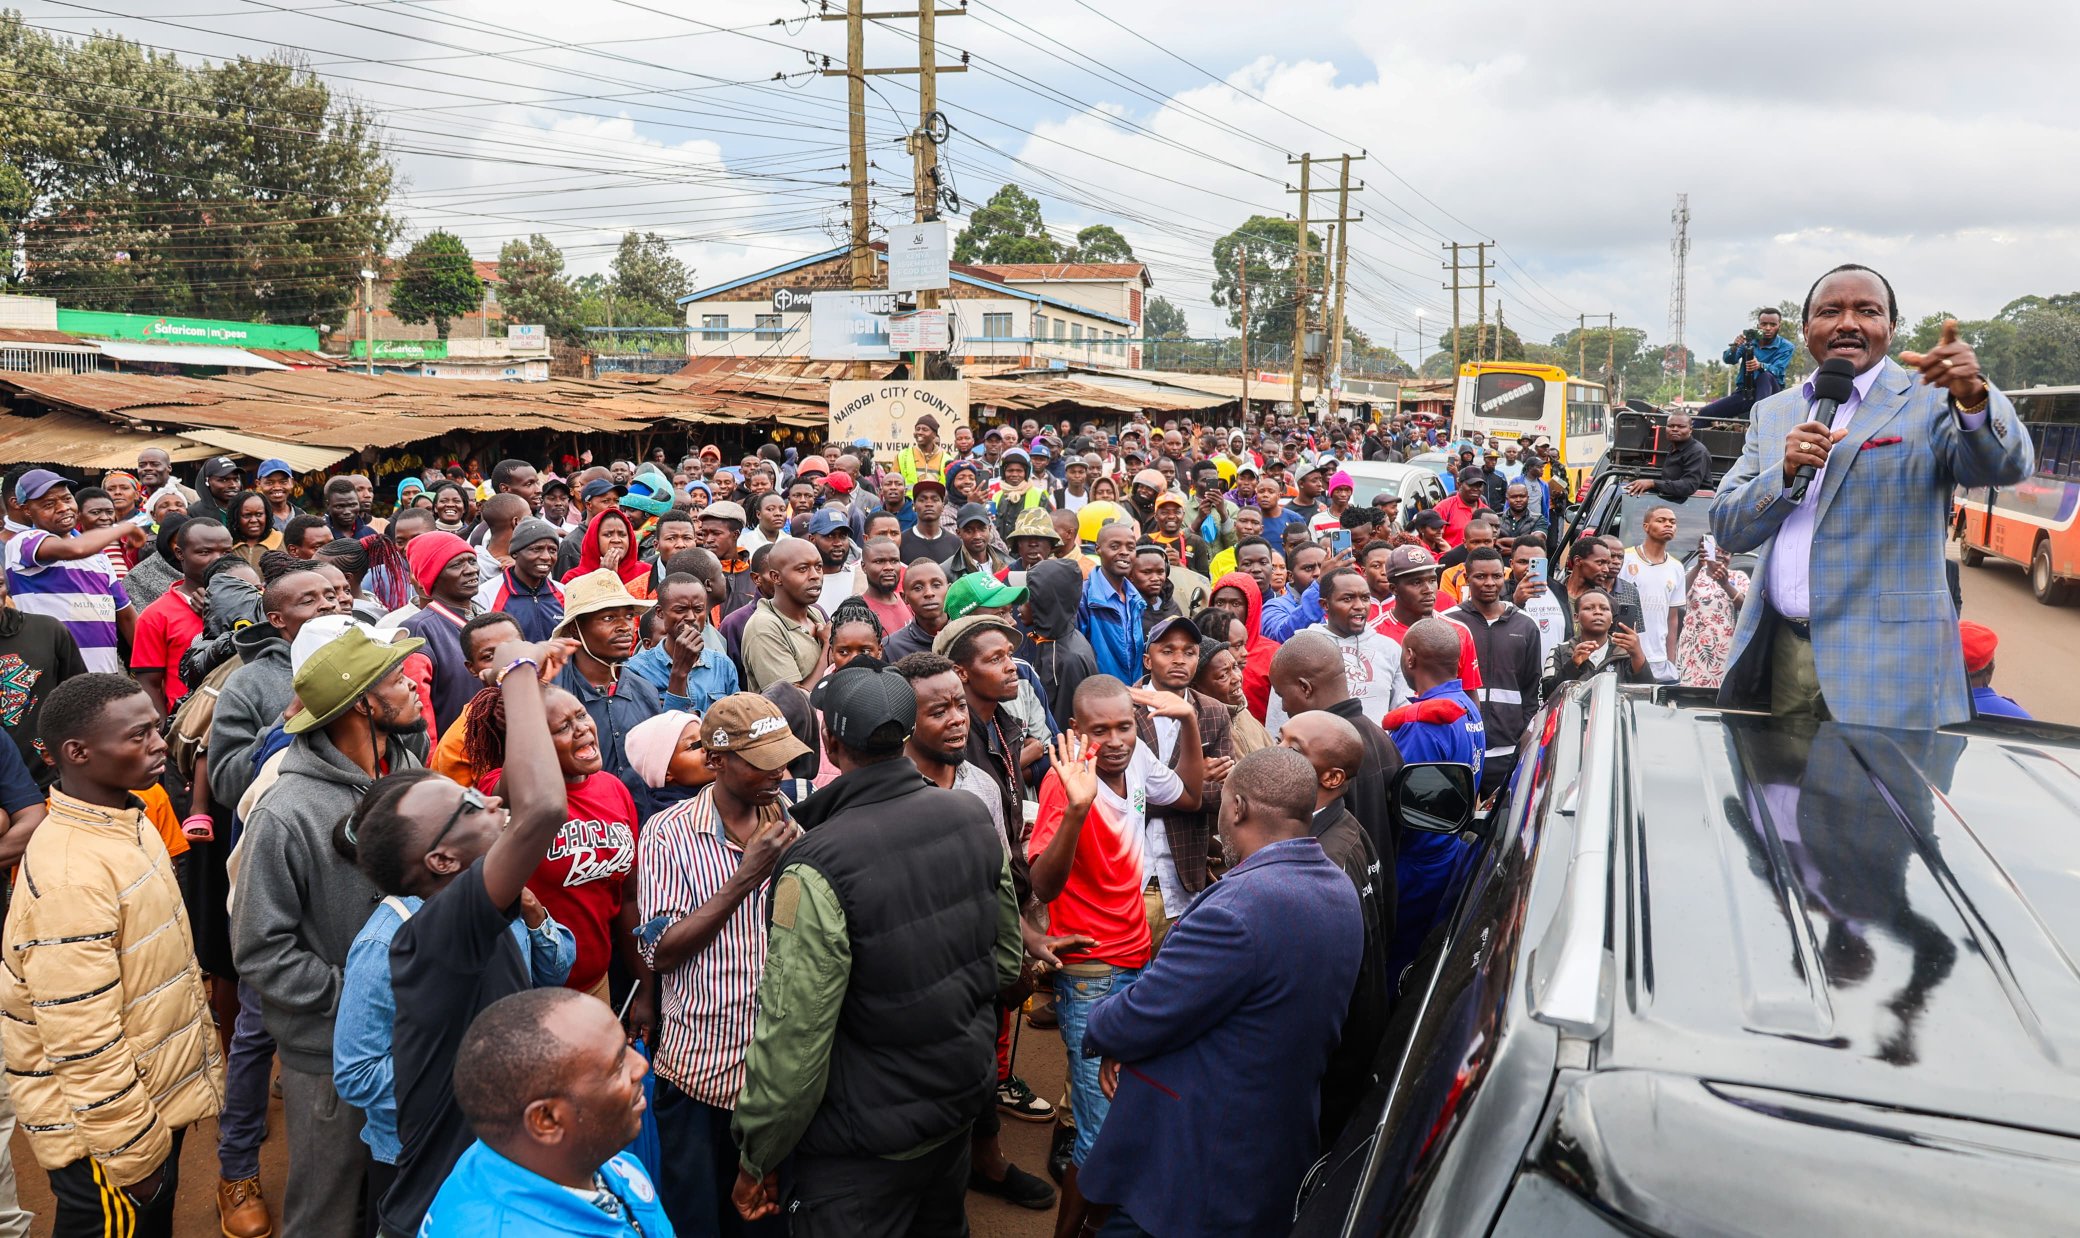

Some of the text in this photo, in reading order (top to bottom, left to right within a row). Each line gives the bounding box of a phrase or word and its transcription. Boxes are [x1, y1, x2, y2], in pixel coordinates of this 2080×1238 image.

[154, 323, 206, 336] Safaricom
[833, 387, 961, 424] NAIROBI CITY COUNTY
[833, 441, 883, 451] MOUIN
[887, 442, 910, 451] VIEW
[562, 845, 635, 887] Bulls
